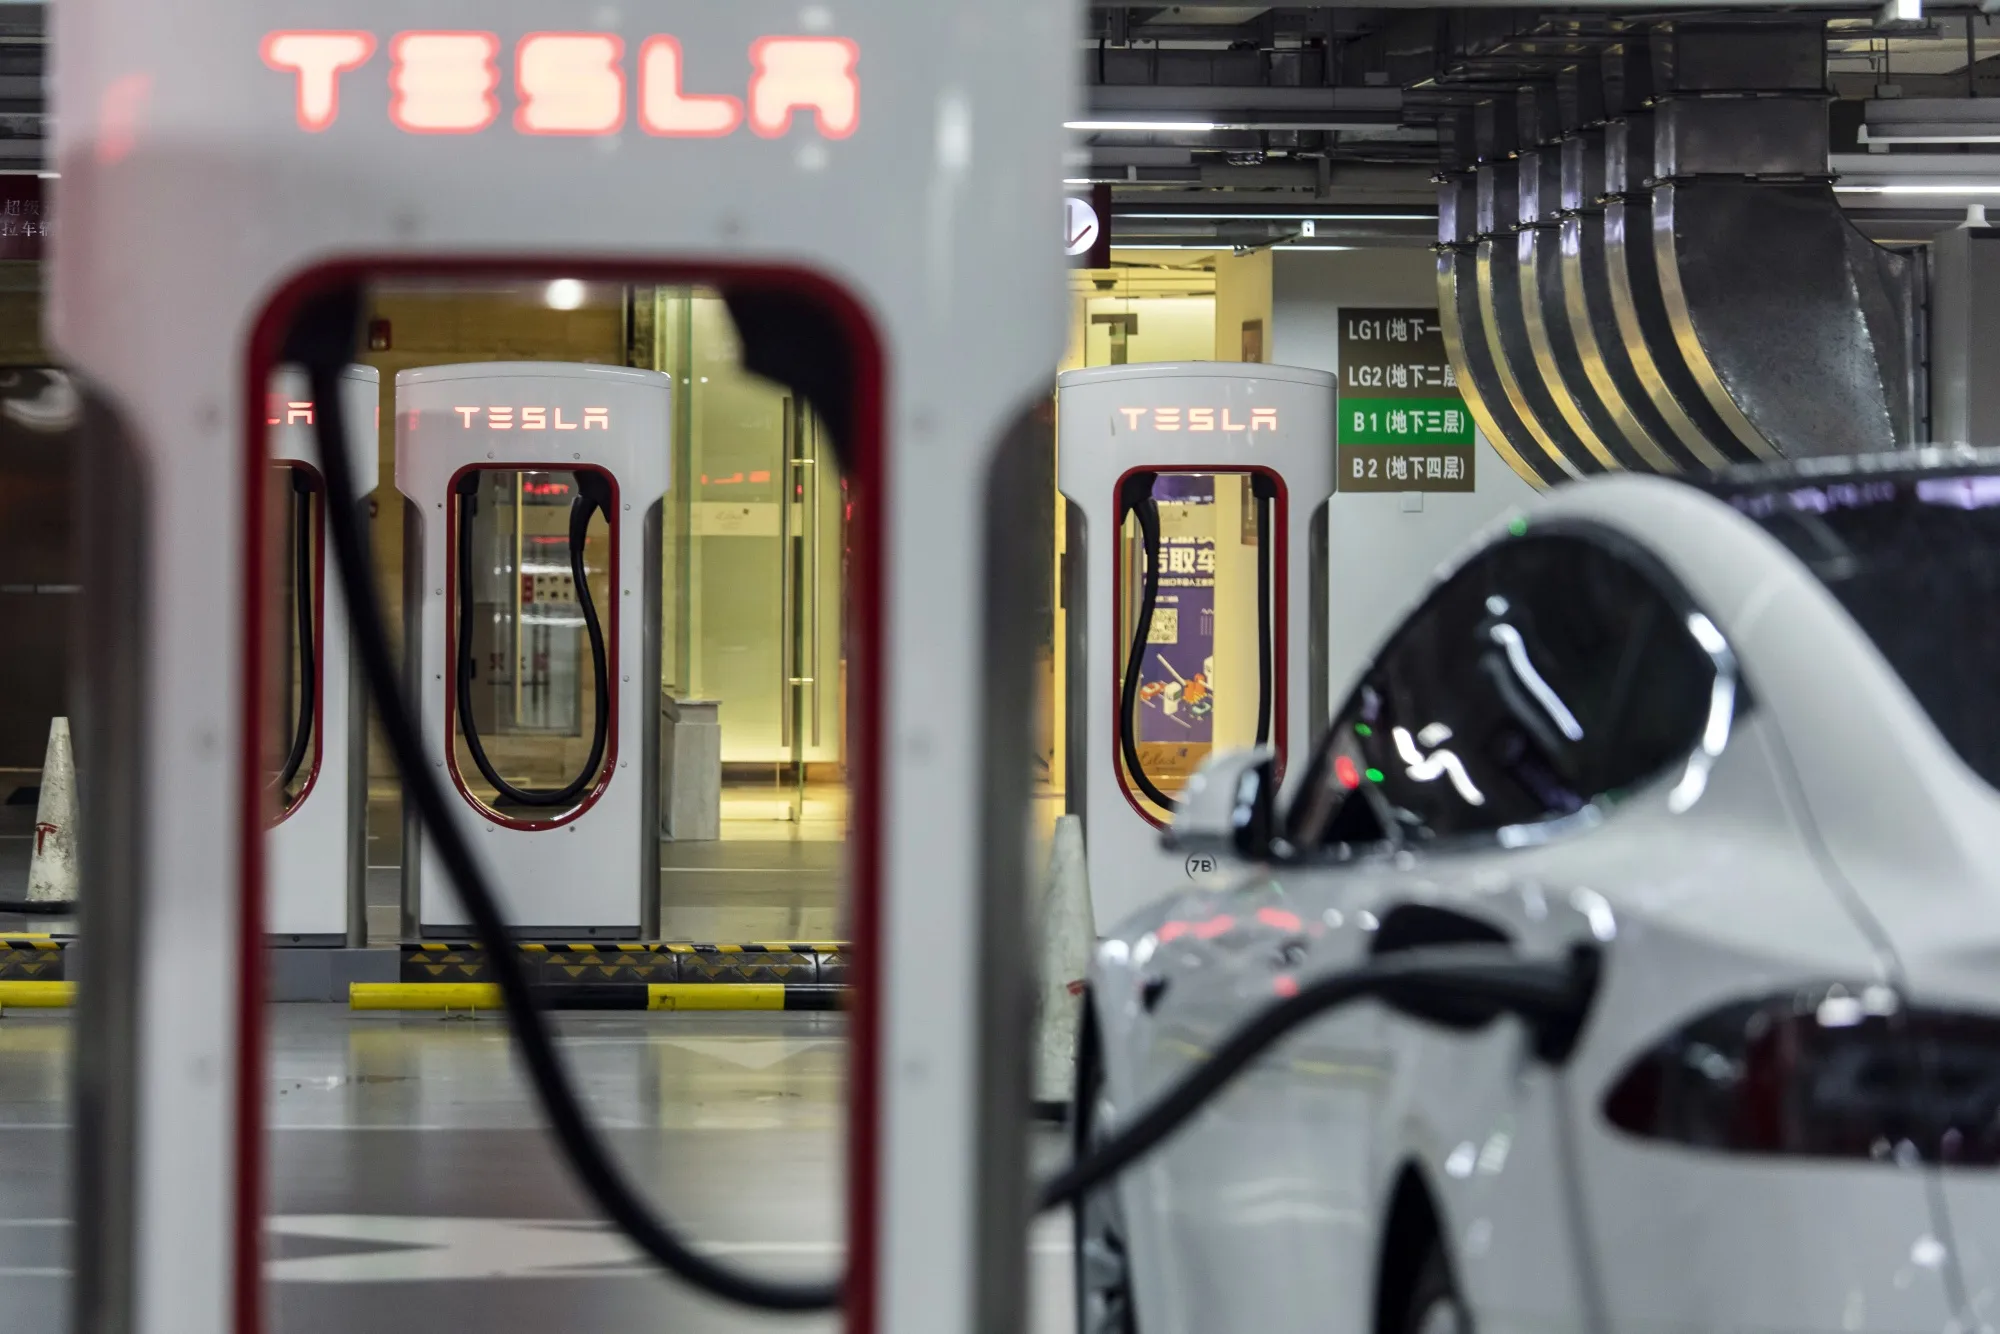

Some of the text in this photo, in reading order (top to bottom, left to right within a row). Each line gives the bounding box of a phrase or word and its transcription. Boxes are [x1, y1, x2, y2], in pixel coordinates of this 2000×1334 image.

[260, 30, 860, 139] TESLA
[1349, 320, 1381, 340] LG1
[1349, 366, 1381, 386] LG2
[454, 406, 609, 430] TESLA
[1119, 408, 1277, 431] TESLA
[1191, 860, 1213, 873] 7B
